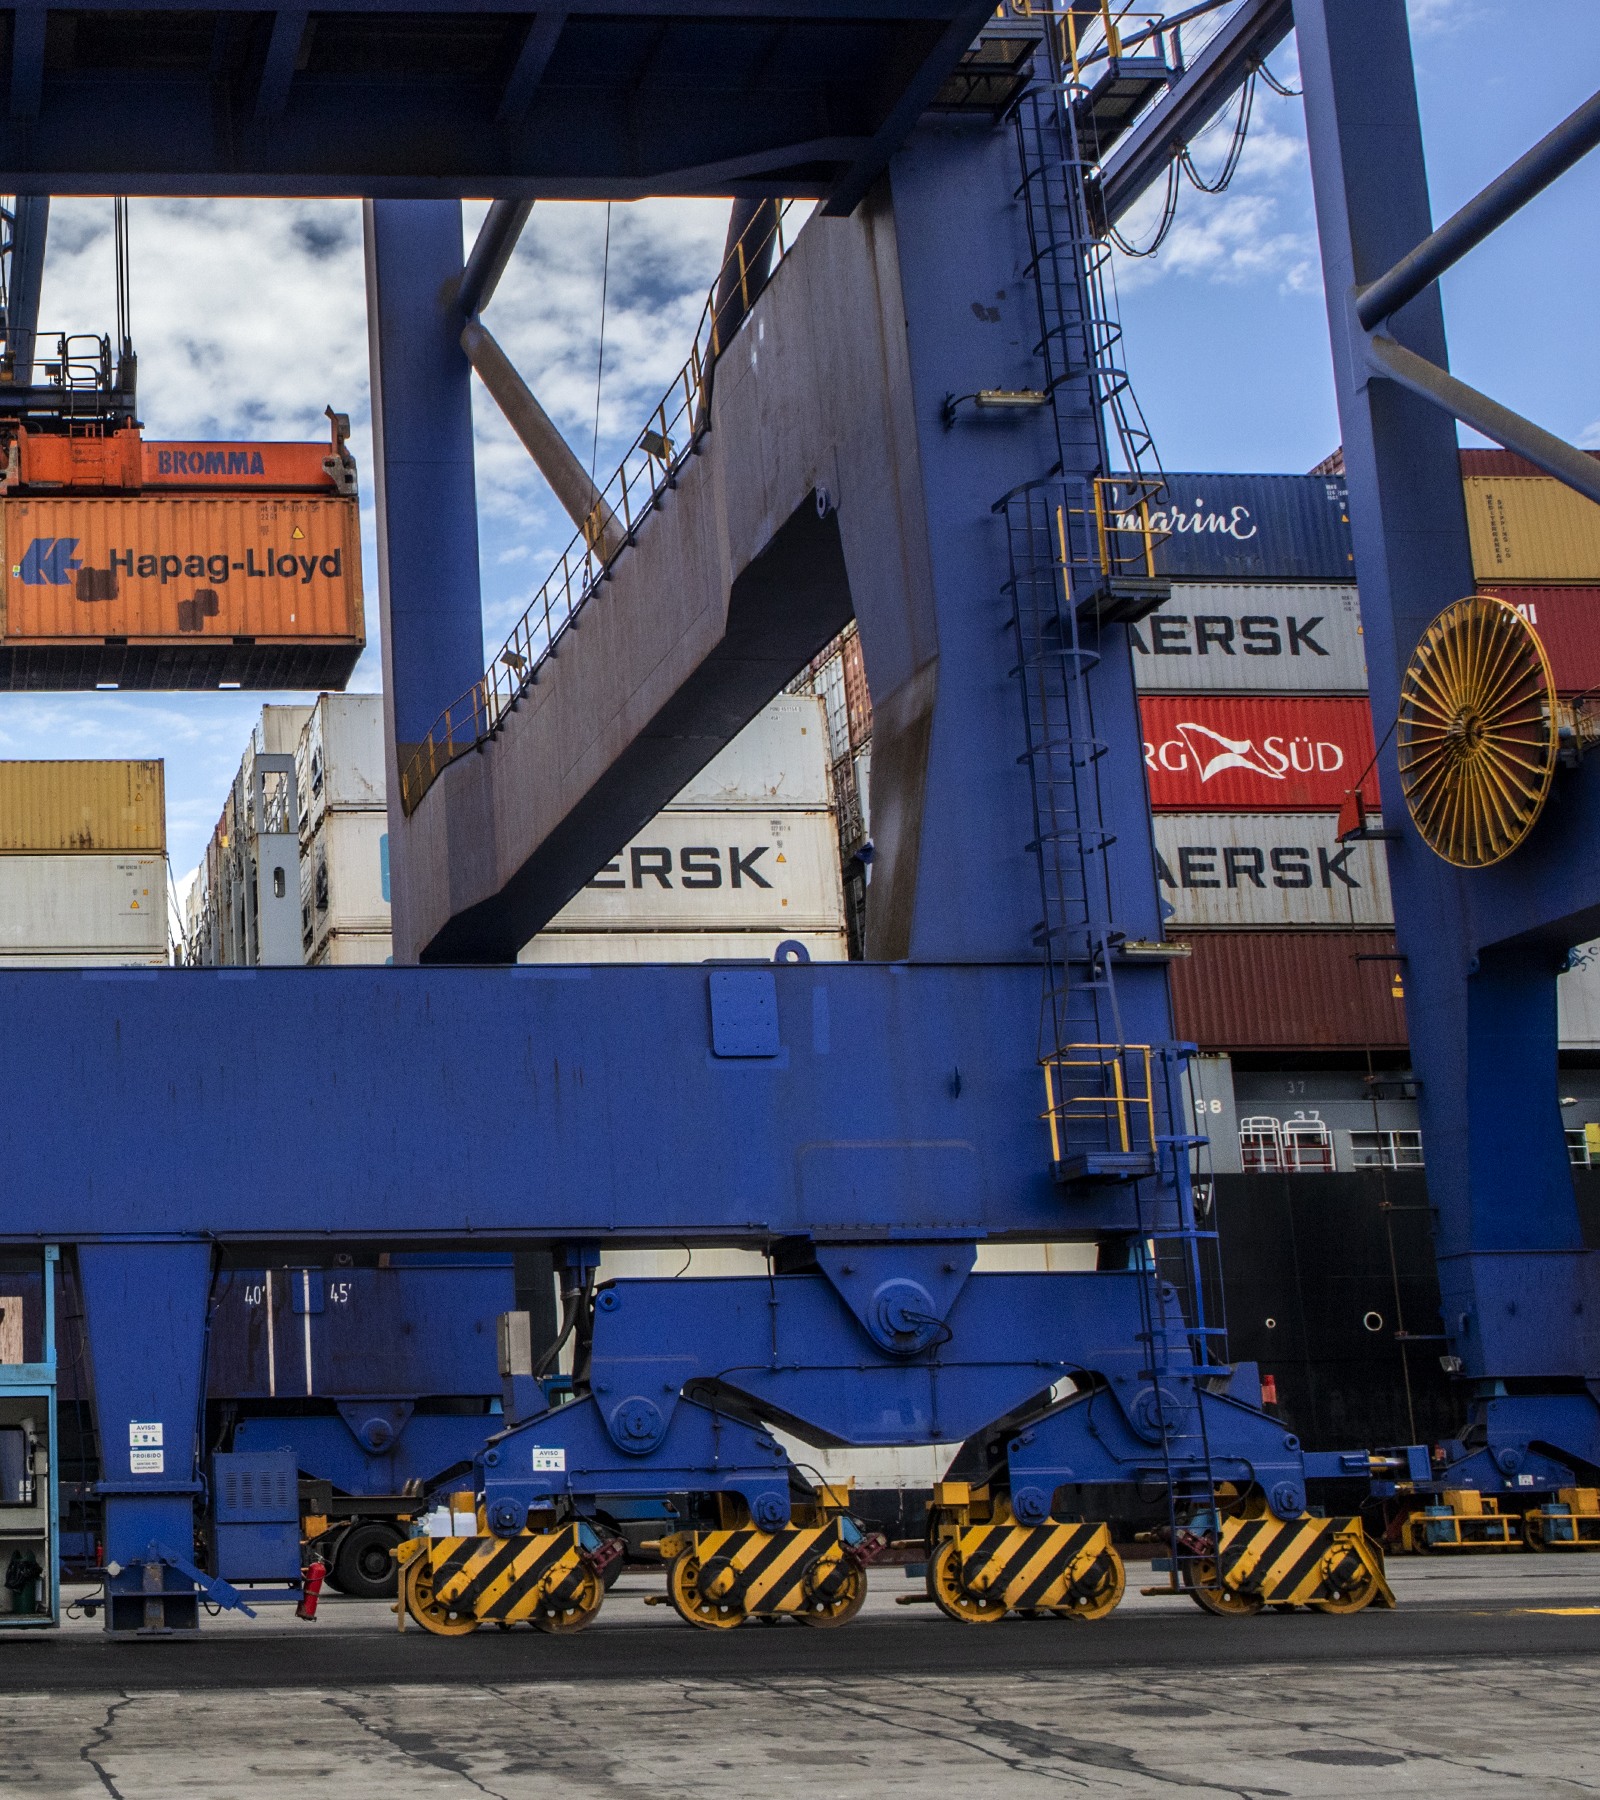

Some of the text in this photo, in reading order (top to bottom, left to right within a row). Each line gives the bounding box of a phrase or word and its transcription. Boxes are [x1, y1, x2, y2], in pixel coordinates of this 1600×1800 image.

[158, 451, 265, 475] BROMMA
[110, 548, 342, 584] Hapag-Lloyd
[1264, 736, 1344, 772] SÜD
[1287, 1081, 1305, 1093] 37
[1195, 1100, 1221, 1113] 38
